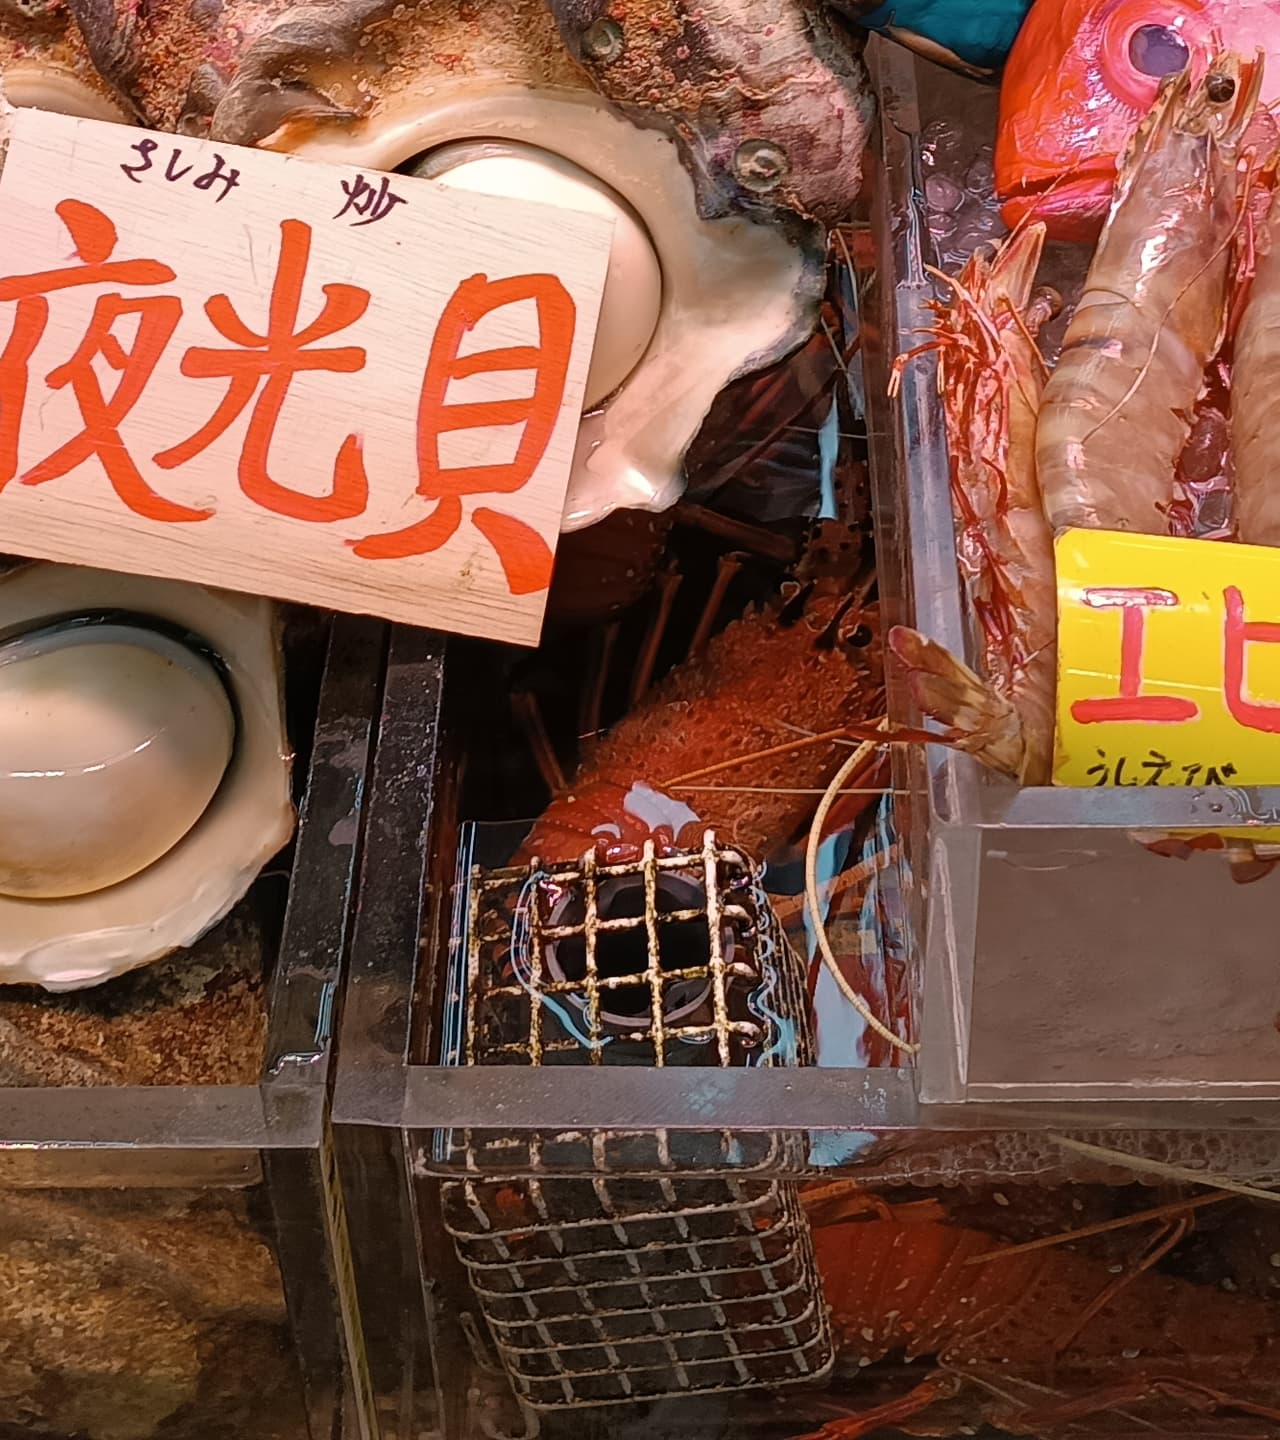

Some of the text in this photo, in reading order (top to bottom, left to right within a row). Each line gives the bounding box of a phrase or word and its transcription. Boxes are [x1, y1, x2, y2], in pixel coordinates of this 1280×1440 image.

[120, 138, 410, 227] さしみ 炒
